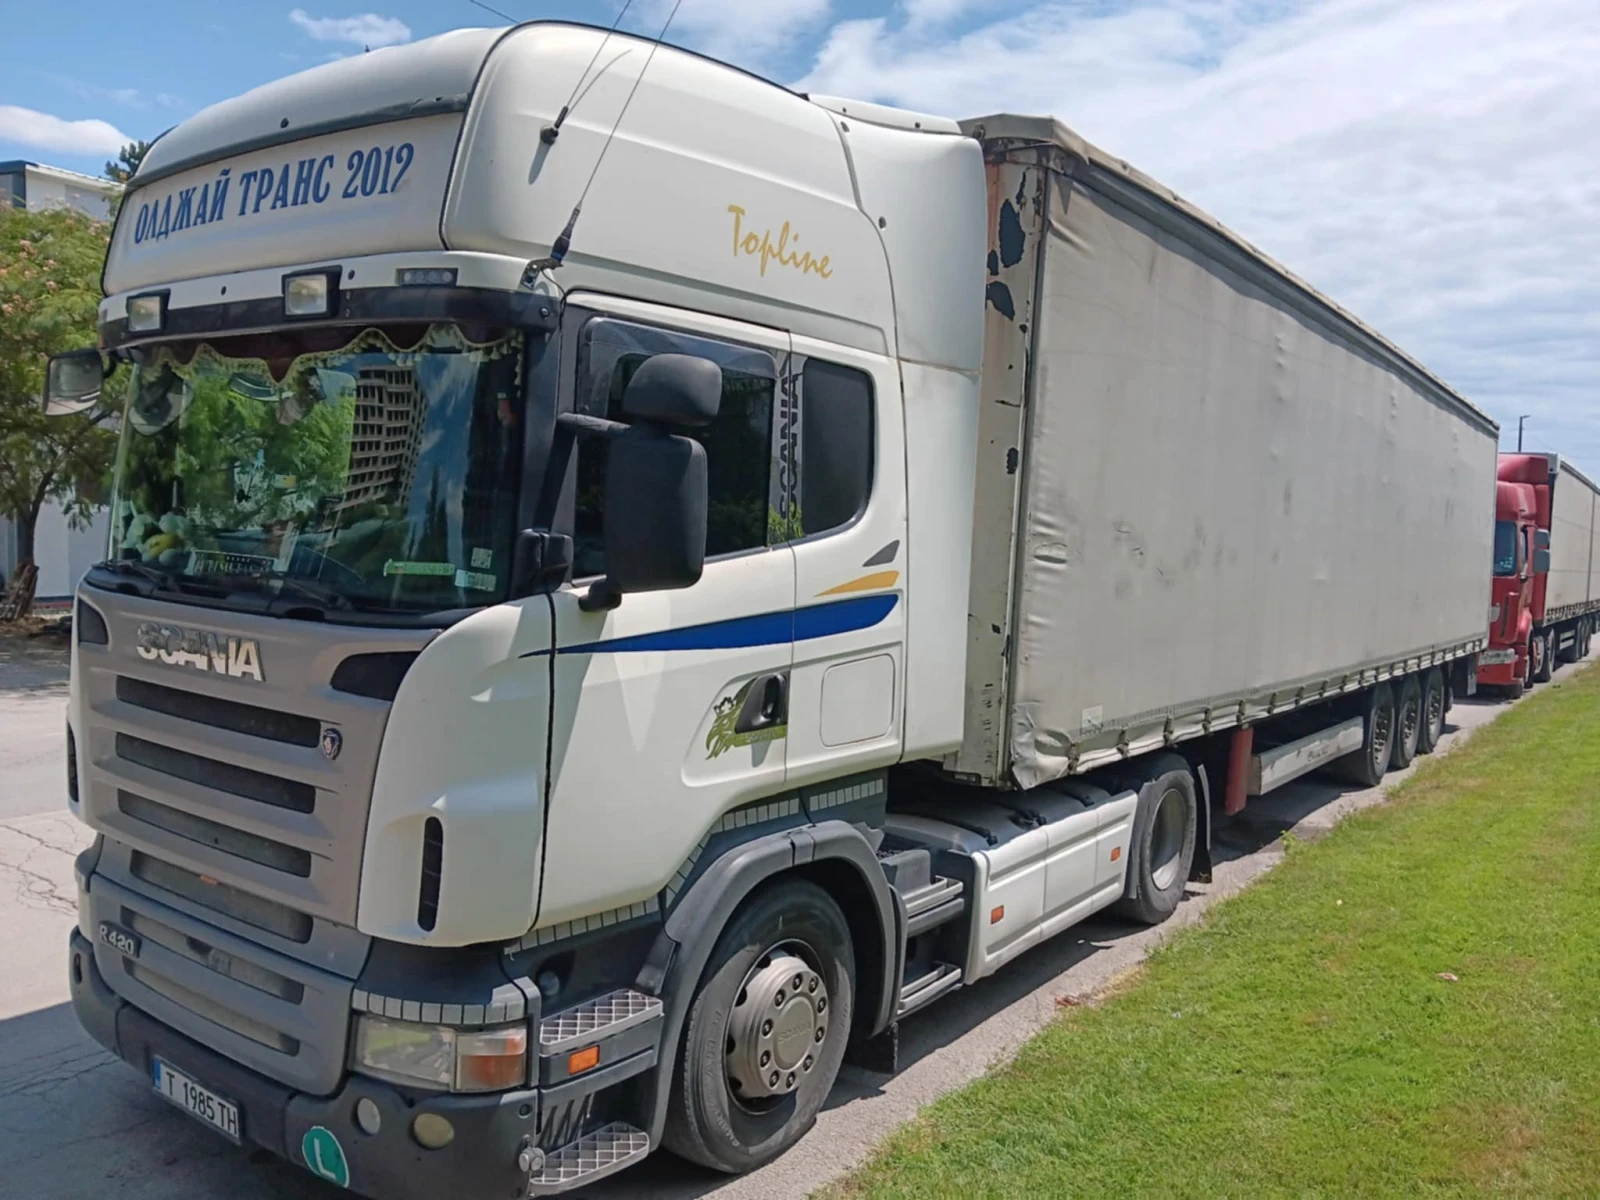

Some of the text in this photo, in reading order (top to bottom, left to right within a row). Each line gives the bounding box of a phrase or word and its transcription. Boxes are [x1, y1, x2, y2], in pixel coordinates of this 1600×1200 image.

[134, 168, 232, 245] ОЛДЖАЙ
[237, 154, 335, 216] ТРАНС
[727, 204, 834, 279] Topline
[779, 372, 799, 520] SCANIA
[136, 622, 264, 682] SCANIA
[165, 1071, 237, 1135] T 1985 TH
[313, 1136, 337, 1181] L
